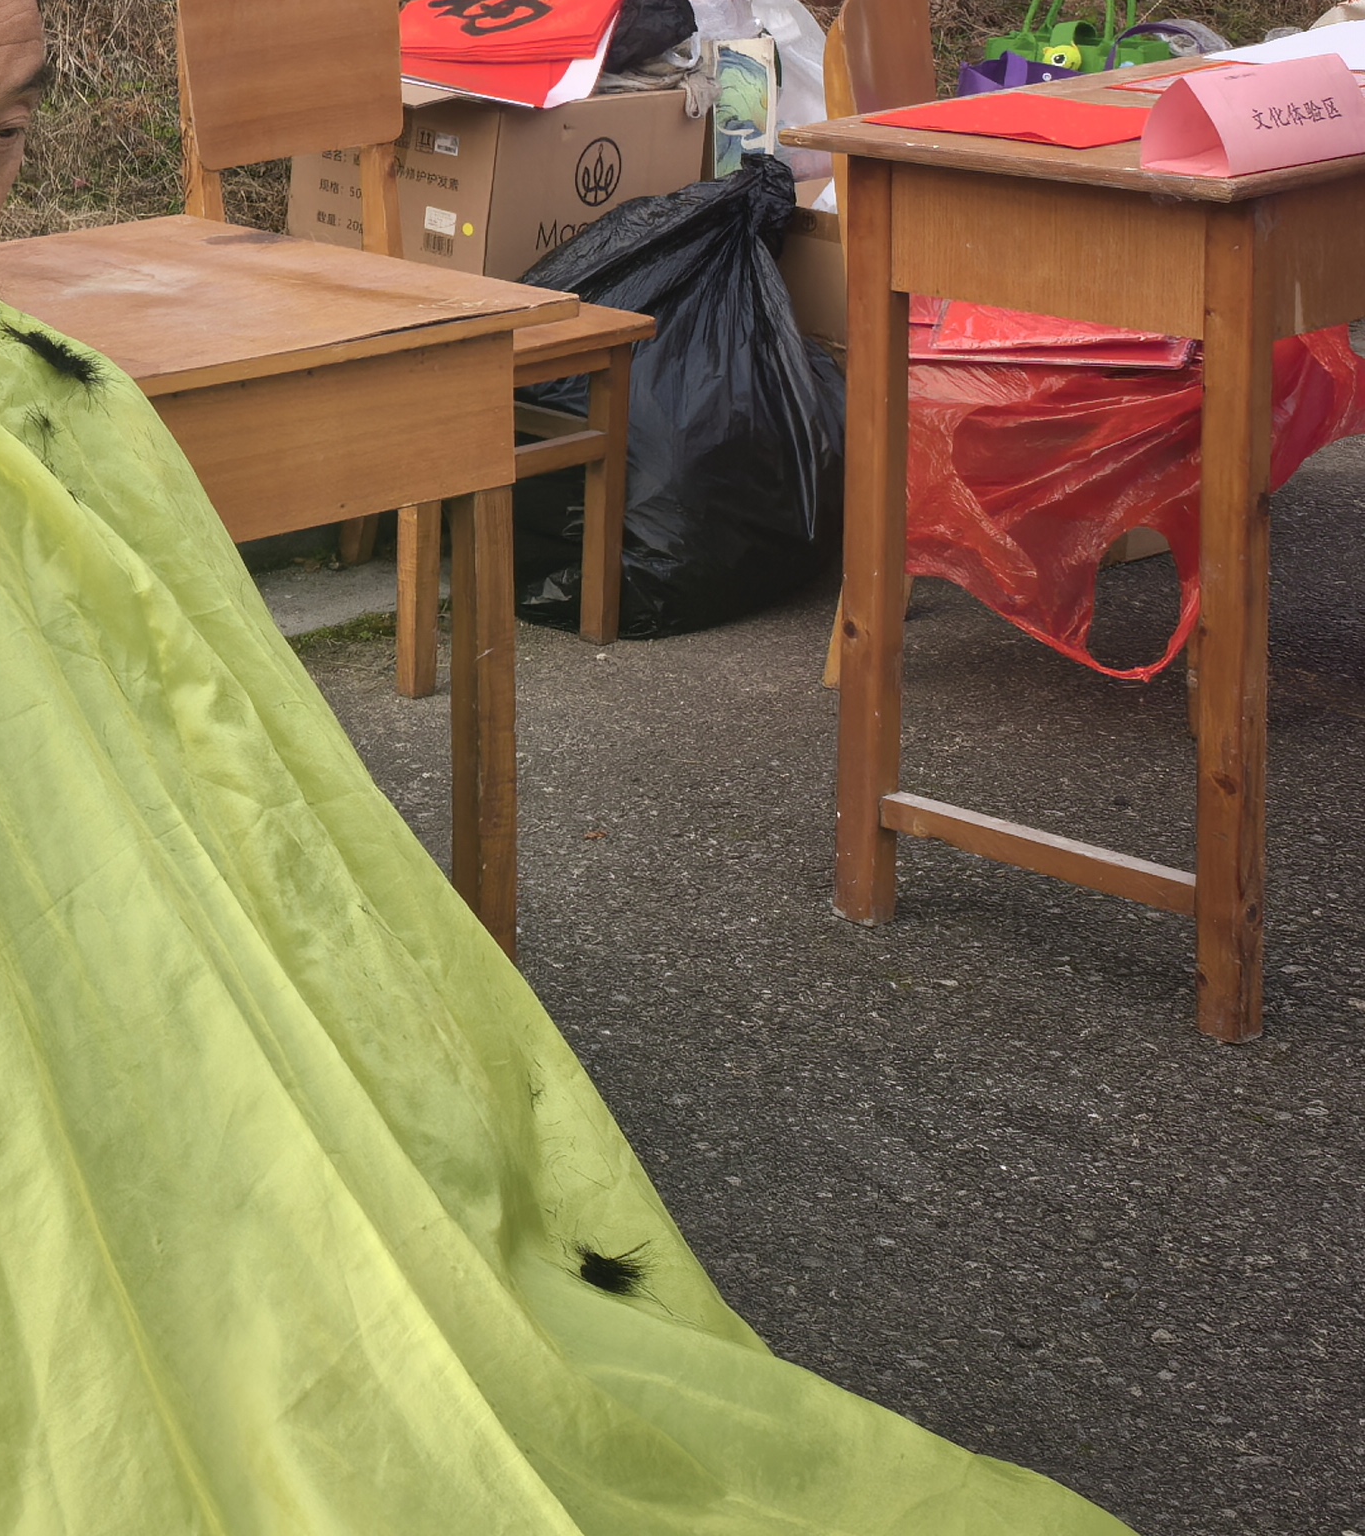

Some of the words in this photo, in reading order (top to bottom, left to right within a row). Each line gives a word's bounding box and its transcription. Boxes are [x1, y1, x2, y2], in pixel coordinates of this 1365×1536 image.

[1252, 97, 1342, 130] 文化体验区
